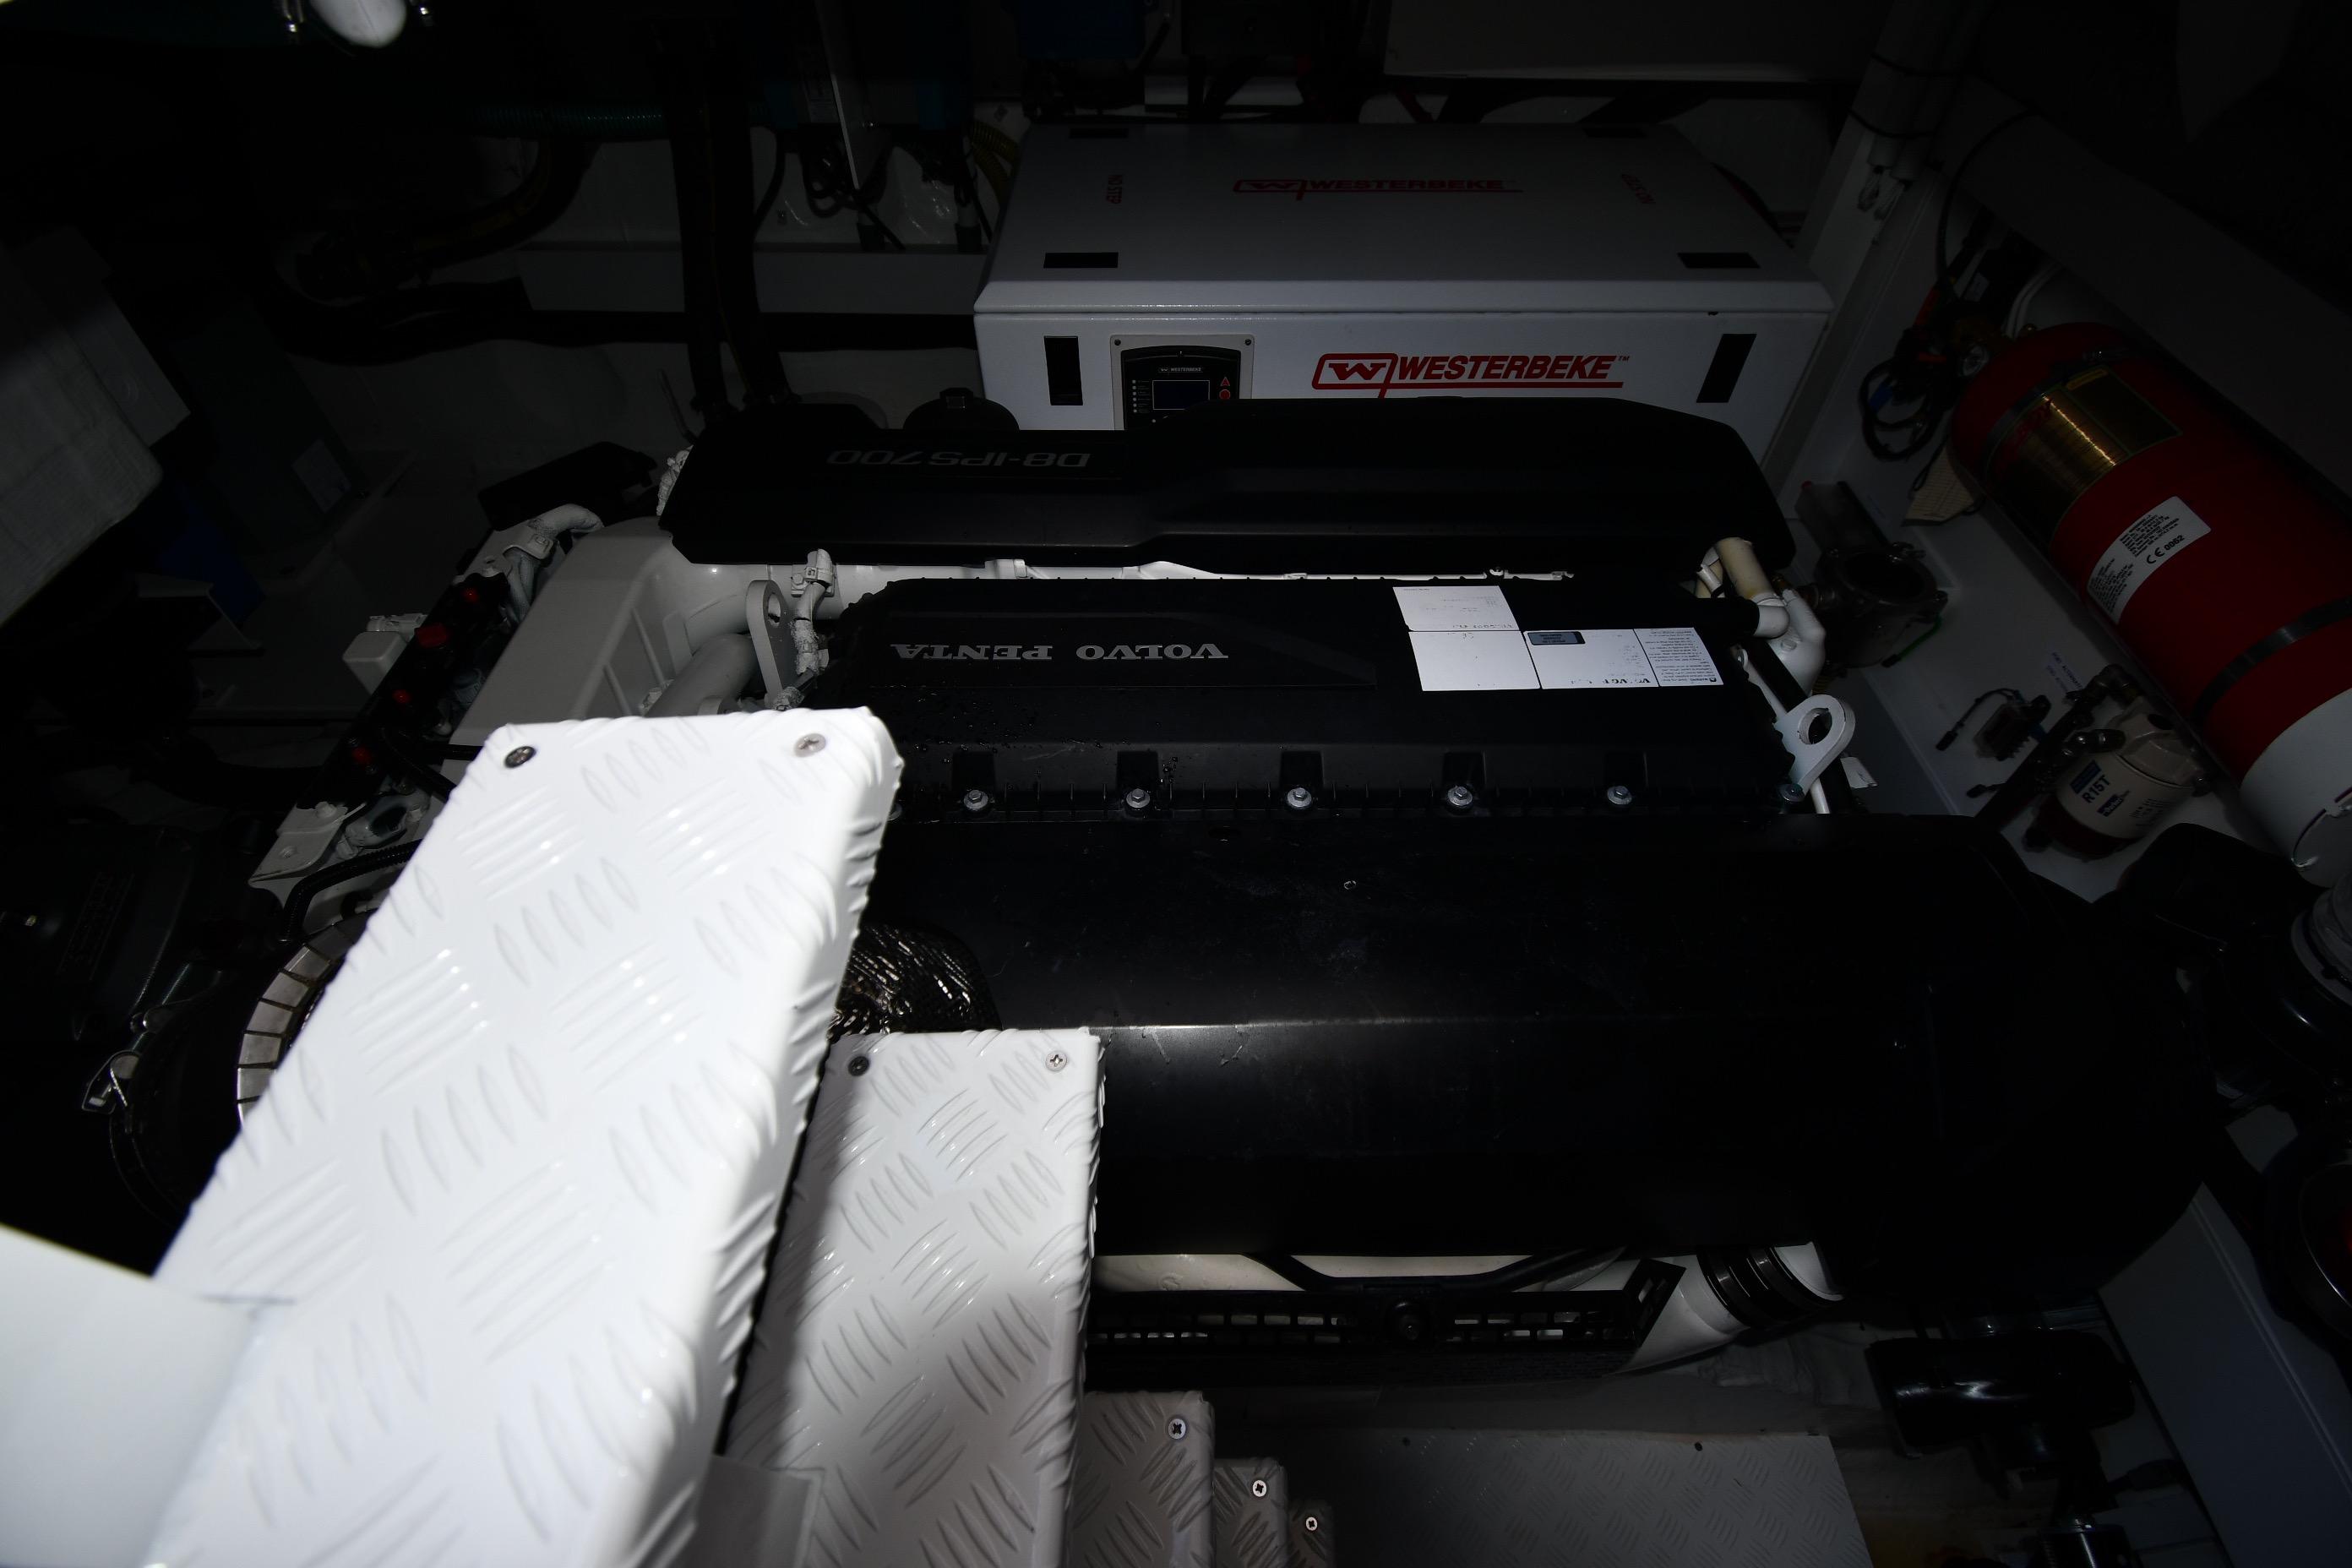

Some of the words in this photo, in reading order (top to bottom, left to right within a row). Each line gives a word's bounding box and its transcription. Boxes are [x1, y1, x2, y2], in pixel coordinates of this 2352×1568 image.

[1310, 180, 1503, 190] WESTERBEKE
[1399, 355, 1617, 380] WESTERBEKE
[889, 643, 1054, 662] PENTA
[1075, 644, 1229, 661] VOLVO
[2082, 774, 2110, 803] R15T
